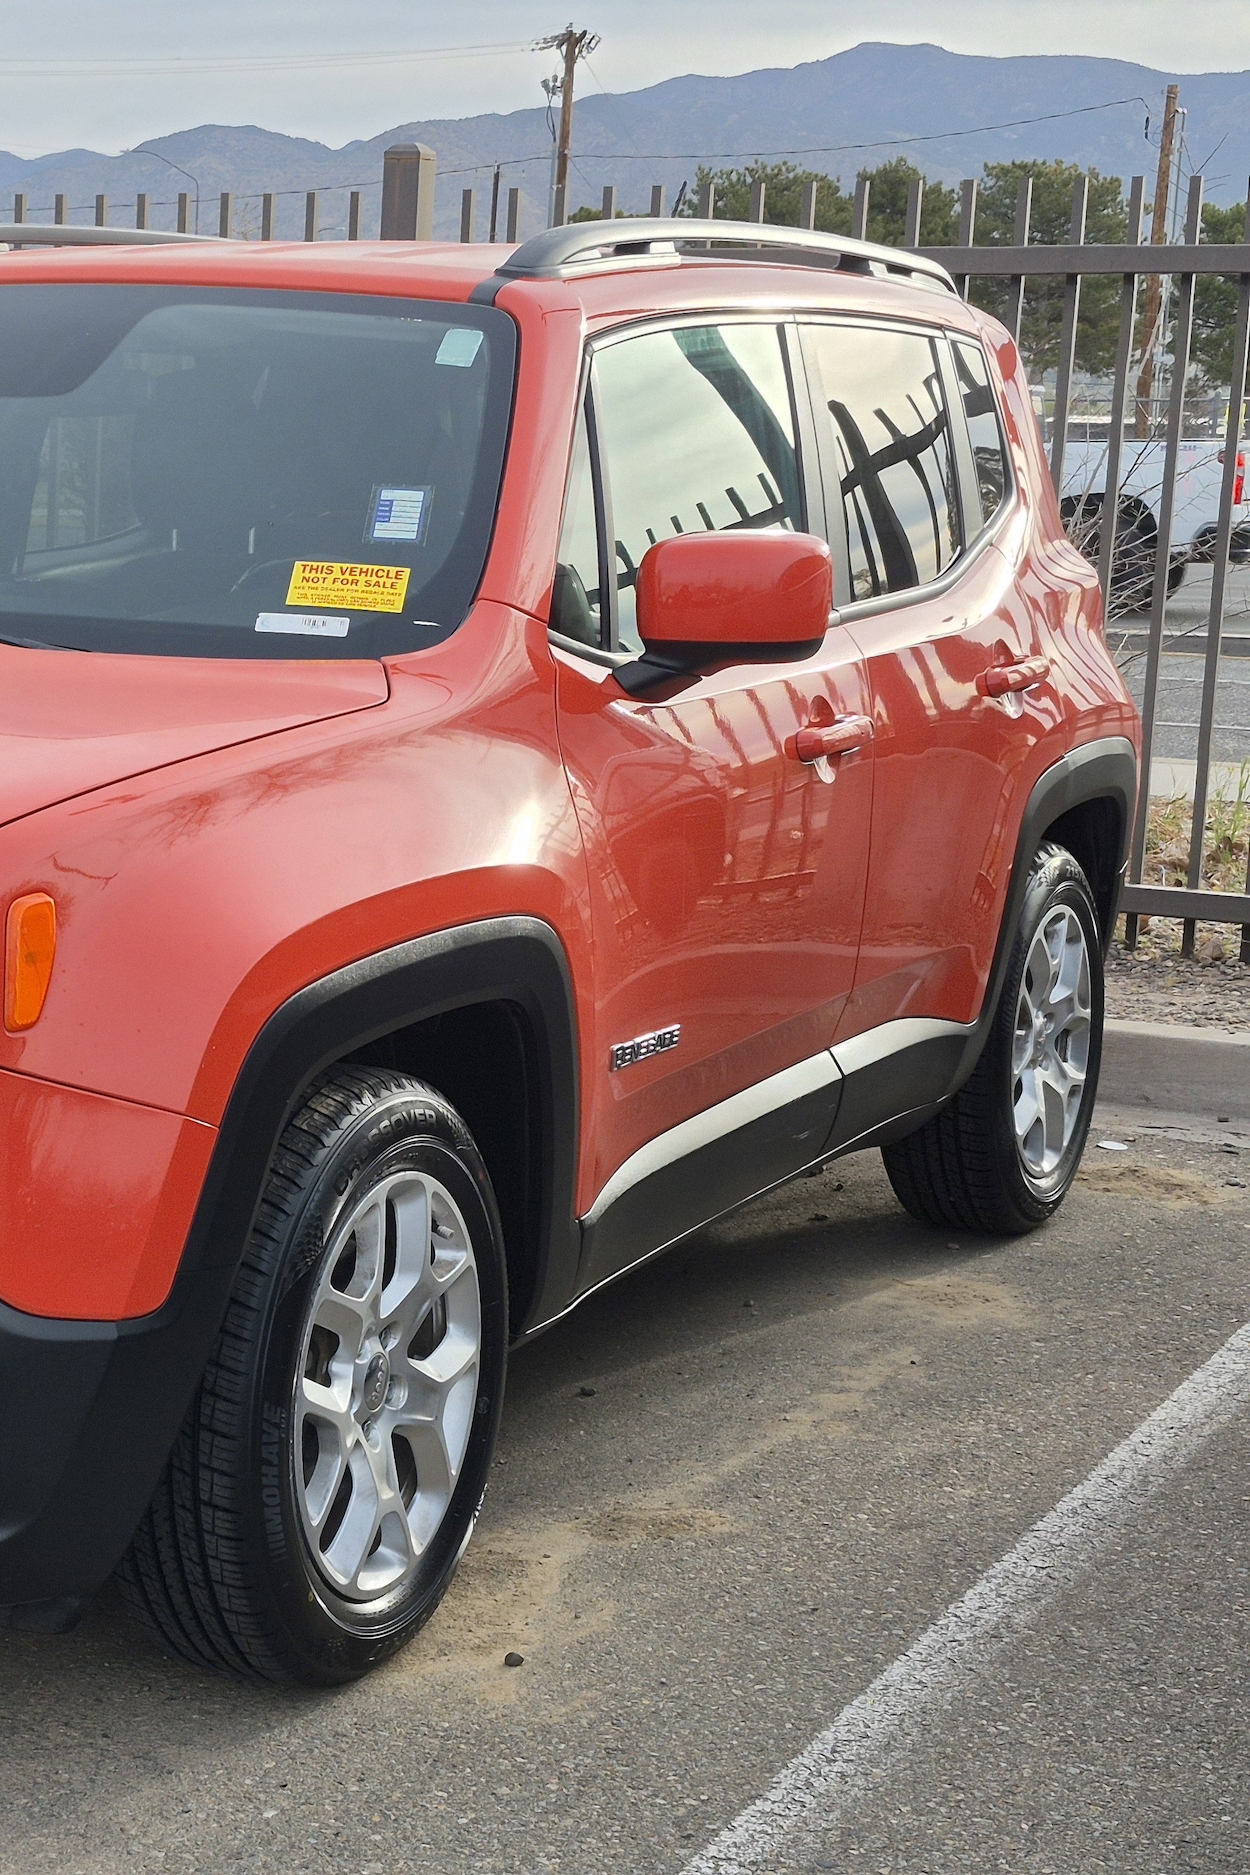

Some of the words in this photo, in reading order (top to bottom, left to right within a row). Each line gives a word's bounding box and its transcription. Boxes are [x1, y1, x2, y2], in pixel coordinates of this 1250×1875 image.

[300, 564, 335, 575] THIS
[339, 566, 405, 580] VEHICLE
[301, 576, 328, 584] NOT
[332, 577, 359, 587] FOR
[364, 579, 399, 590] SALE
[609, 1023, 681, 1073] RENEGADE
[334, 1108, 437, 1197] CROSSOVER
[261, 1401, 284, 1535] MOHAVE
